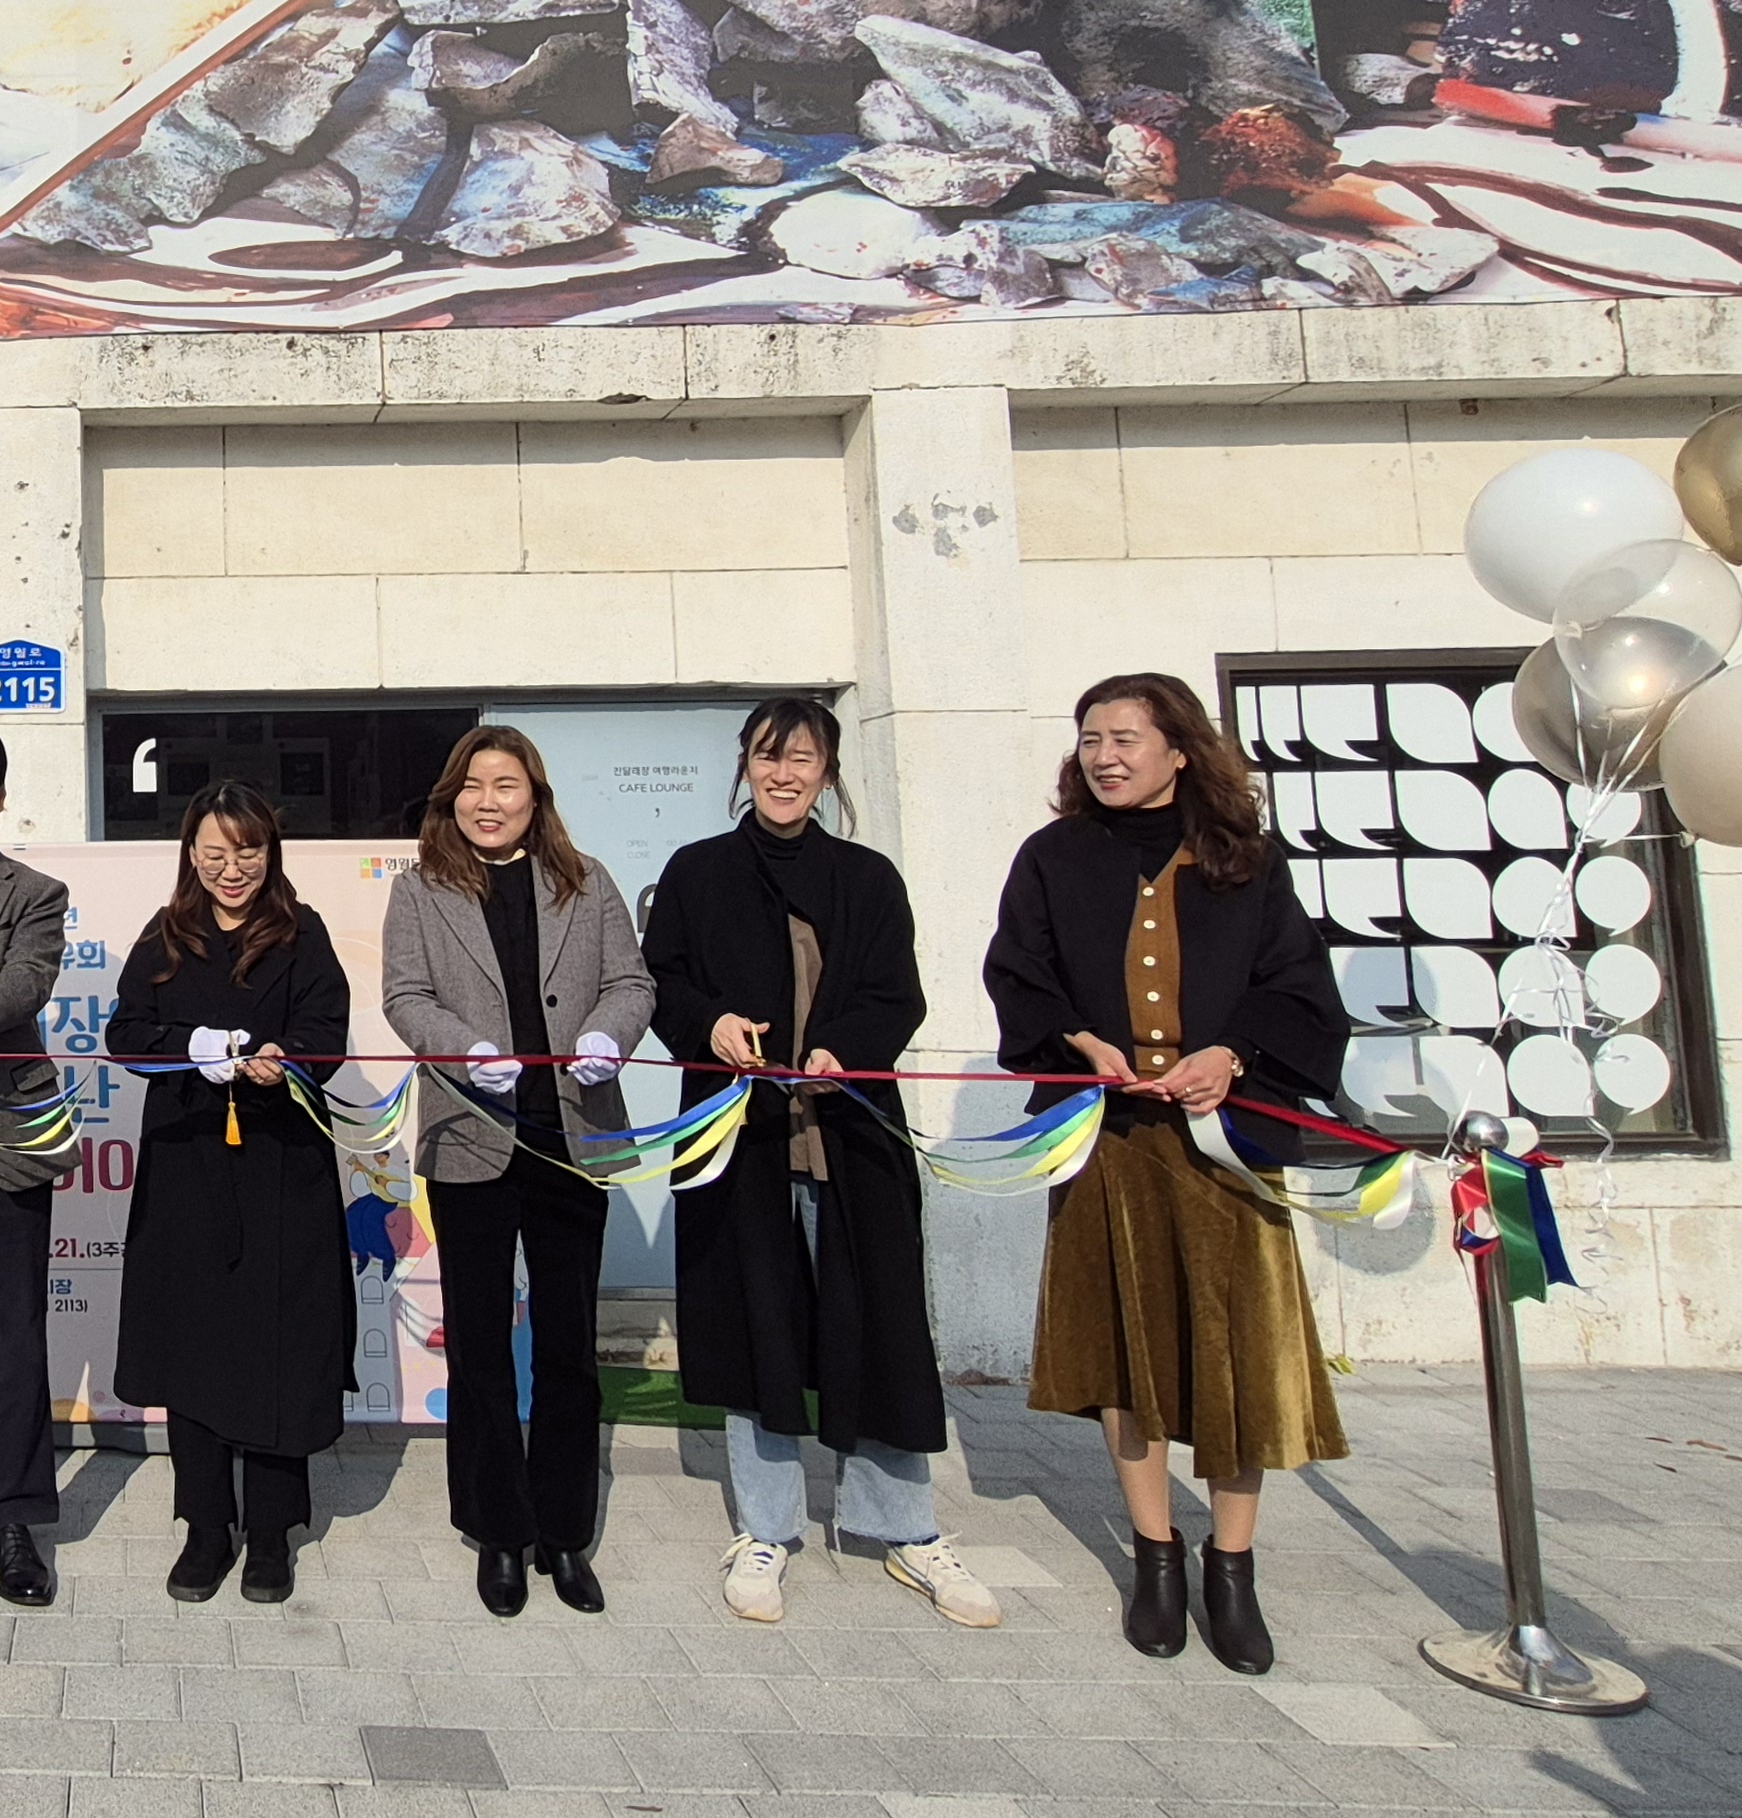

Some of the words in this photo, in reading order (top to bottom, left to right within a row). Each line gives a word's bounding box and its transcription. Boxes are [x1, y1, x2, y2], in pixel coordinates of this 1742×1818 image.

[619, 783, 647, 793] CAFE
[650, 782, 694, 793] LOUNGE
[54, 1299, 88, 1314] 2113)
